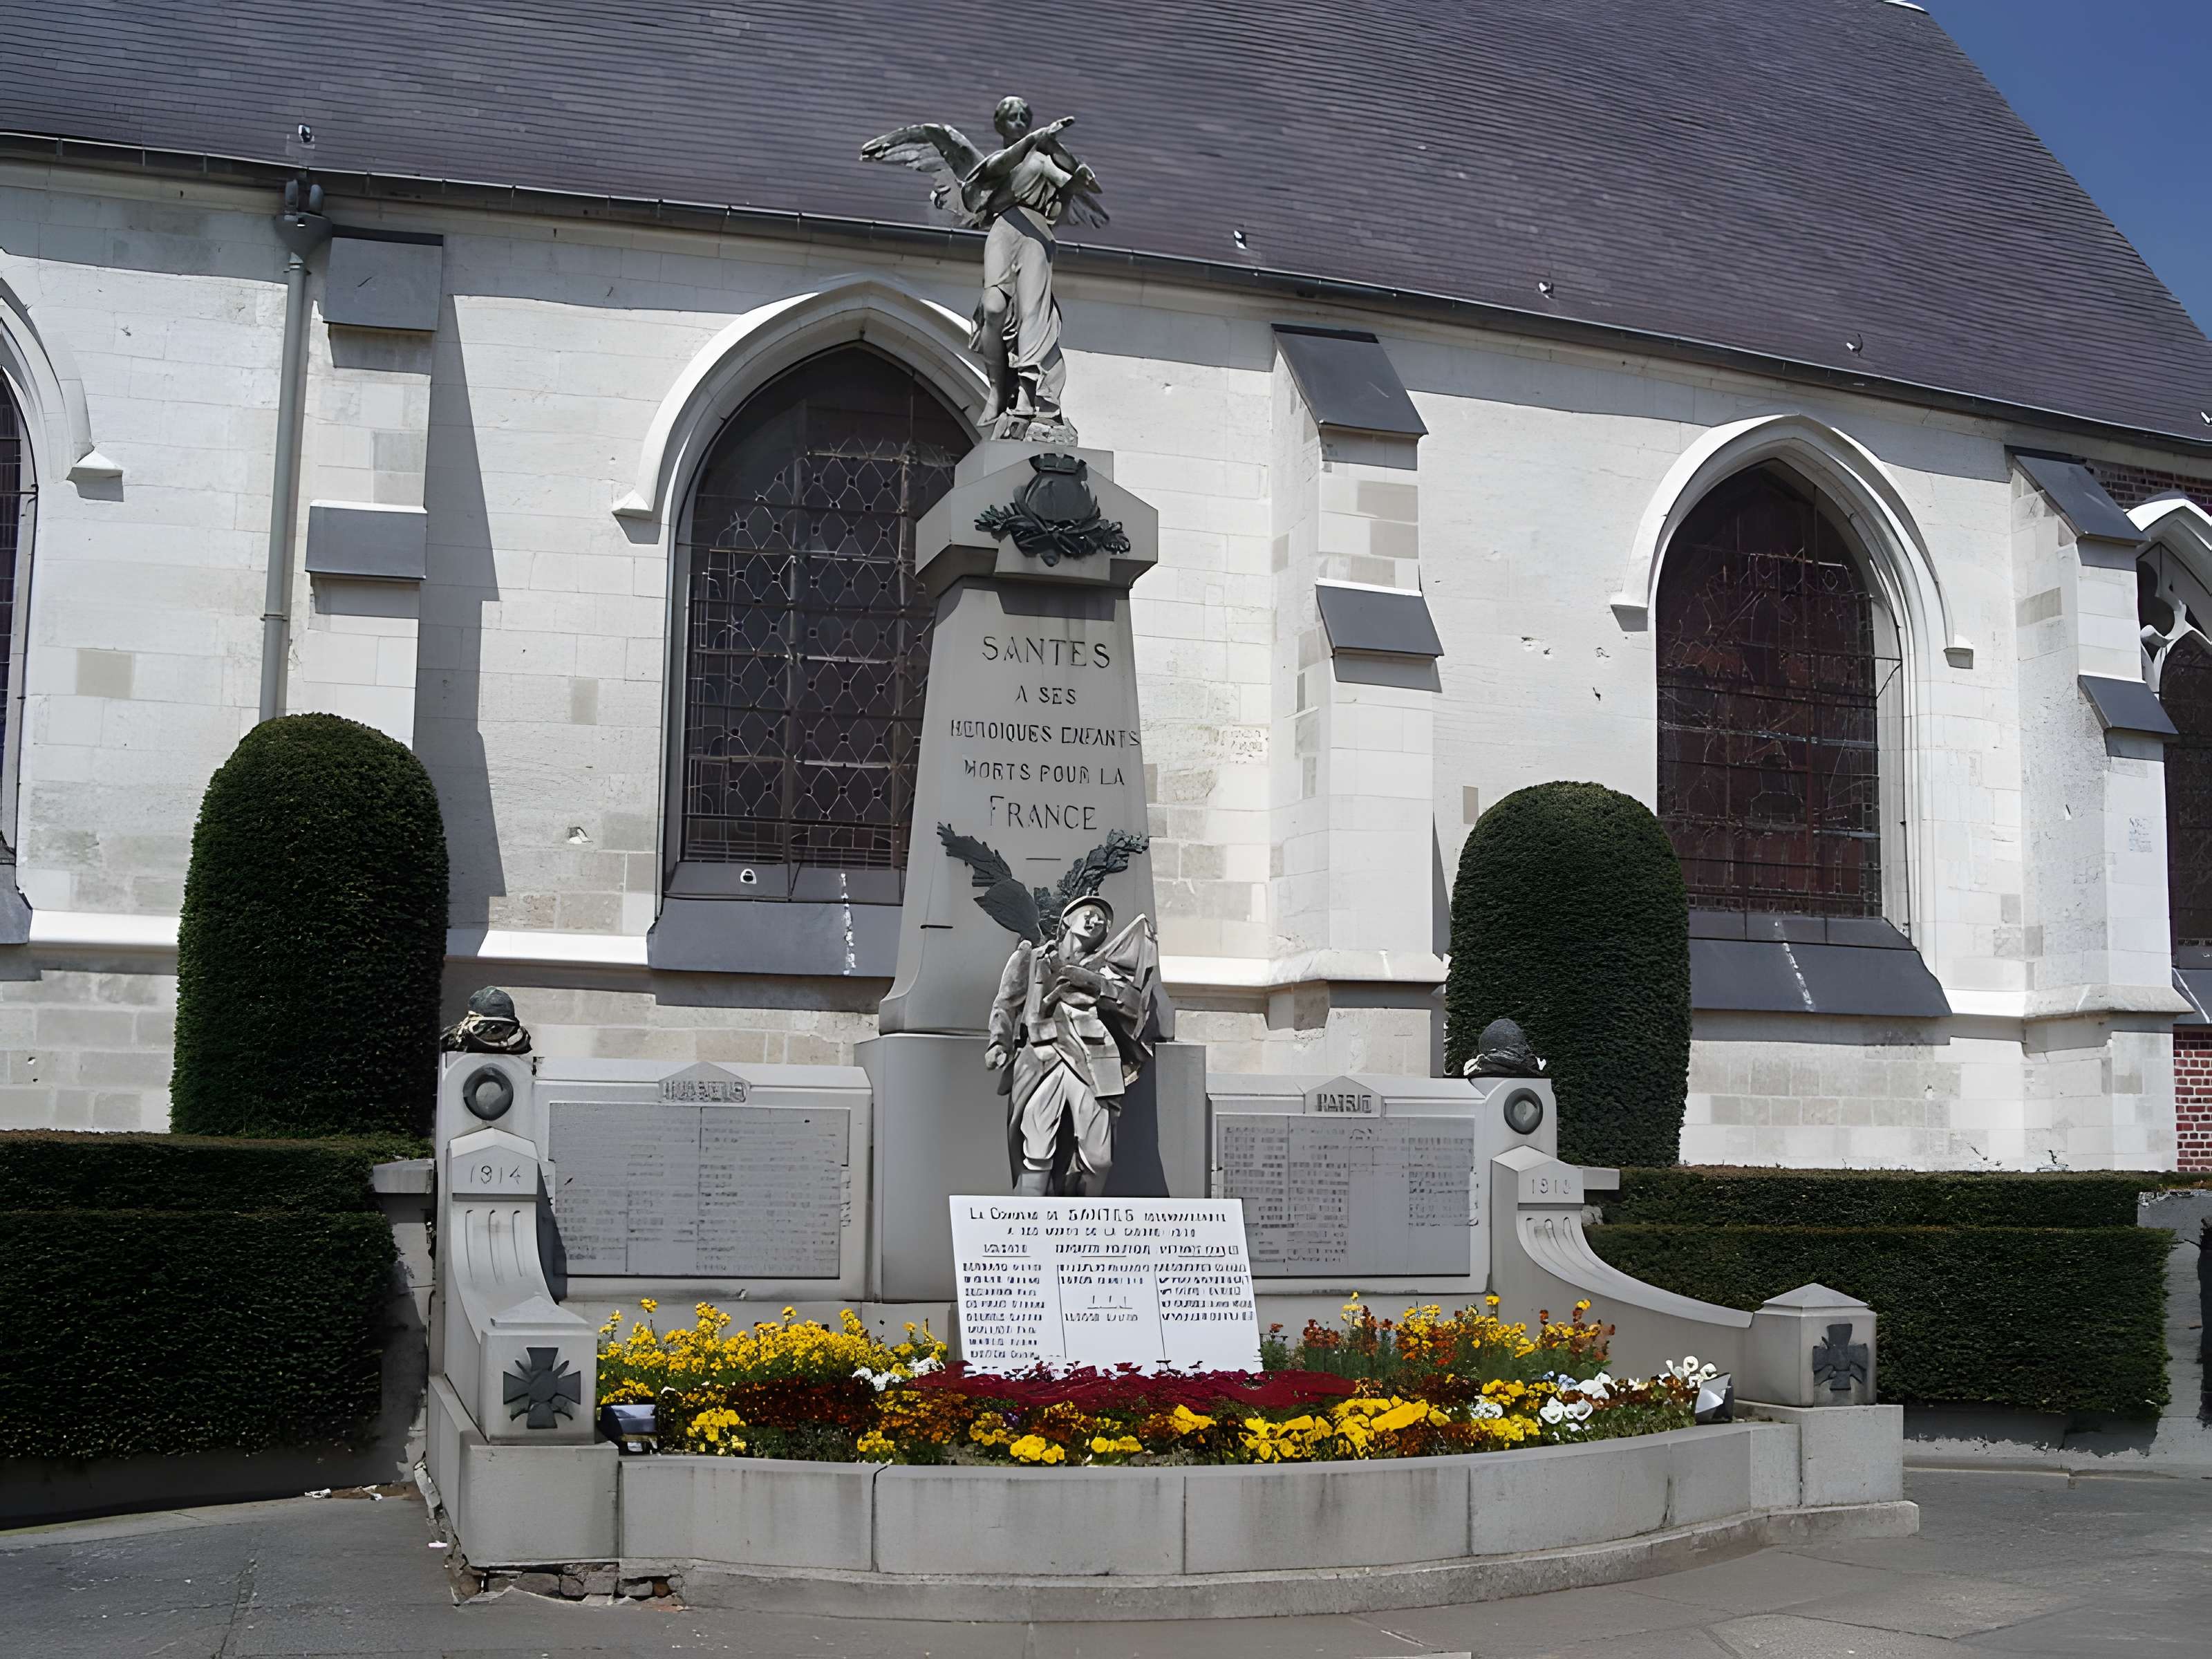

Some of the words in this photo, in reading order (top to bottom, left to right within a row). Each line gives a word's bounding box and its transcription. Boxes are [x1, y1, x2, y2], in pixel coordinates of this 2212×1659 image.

[982, 636, 1111, 668] SANTES
[1038, 686, 1077, 705] SES
[964, 759, 1031, 780] MORTS
[1040, 765, 1090, 784] POUR
[1100, 767, 1125, 786] LA
[989, 795, 1098, 830] FRANCE
[470, 1165, 521, 1185] 1914
